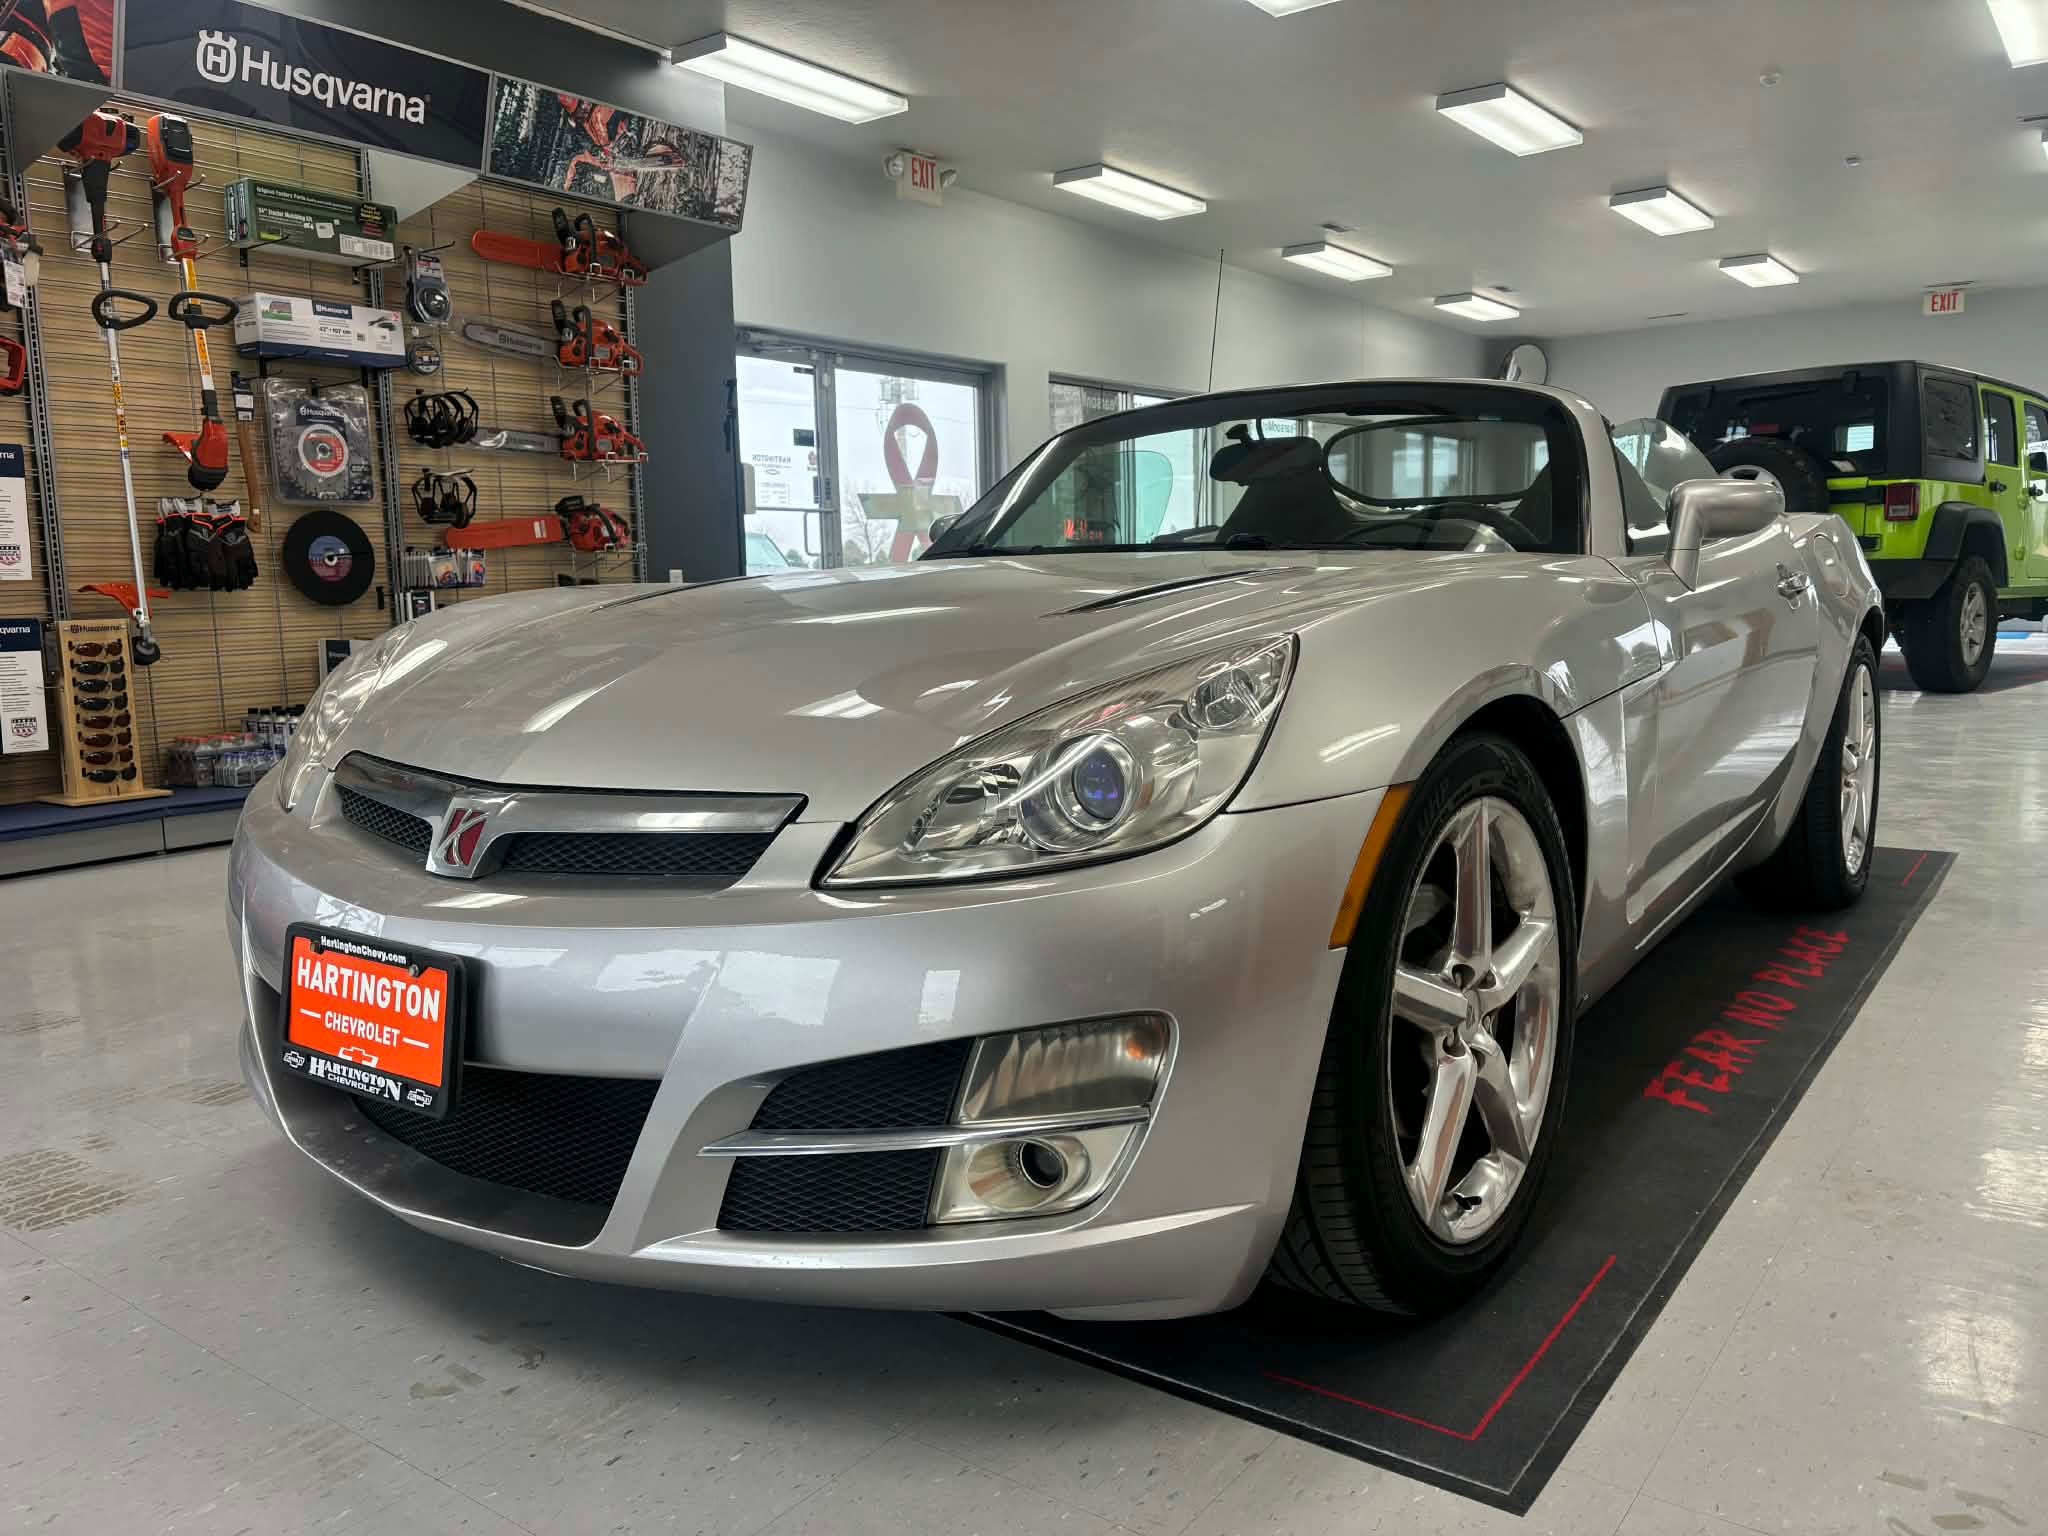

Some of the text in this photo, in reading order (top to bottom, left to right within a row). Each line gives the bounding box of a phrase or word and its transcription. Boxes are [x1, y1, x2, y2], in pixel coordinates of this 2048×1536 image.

[241, 45, 425, 125] Husqvarna
[911, 156, 937, 191] EXIT
[1931, 291, 1959, 312] EXIT
[0, 626, 31, 636] qvarna
[320, 935, 407, 964] HartingtonChevy.com
[297, 956, 441, 1023] HARTINGTON
[324, 1010, 400, 1047] CHEVROLET
[1643, 1028, 1769, 1115] FEAR
[1720, 991, 1798, 1032] NO
[308, 1055, 403, 1101] HARTINGTON
[327, 1072, 381, 1095] CHEVROLET
